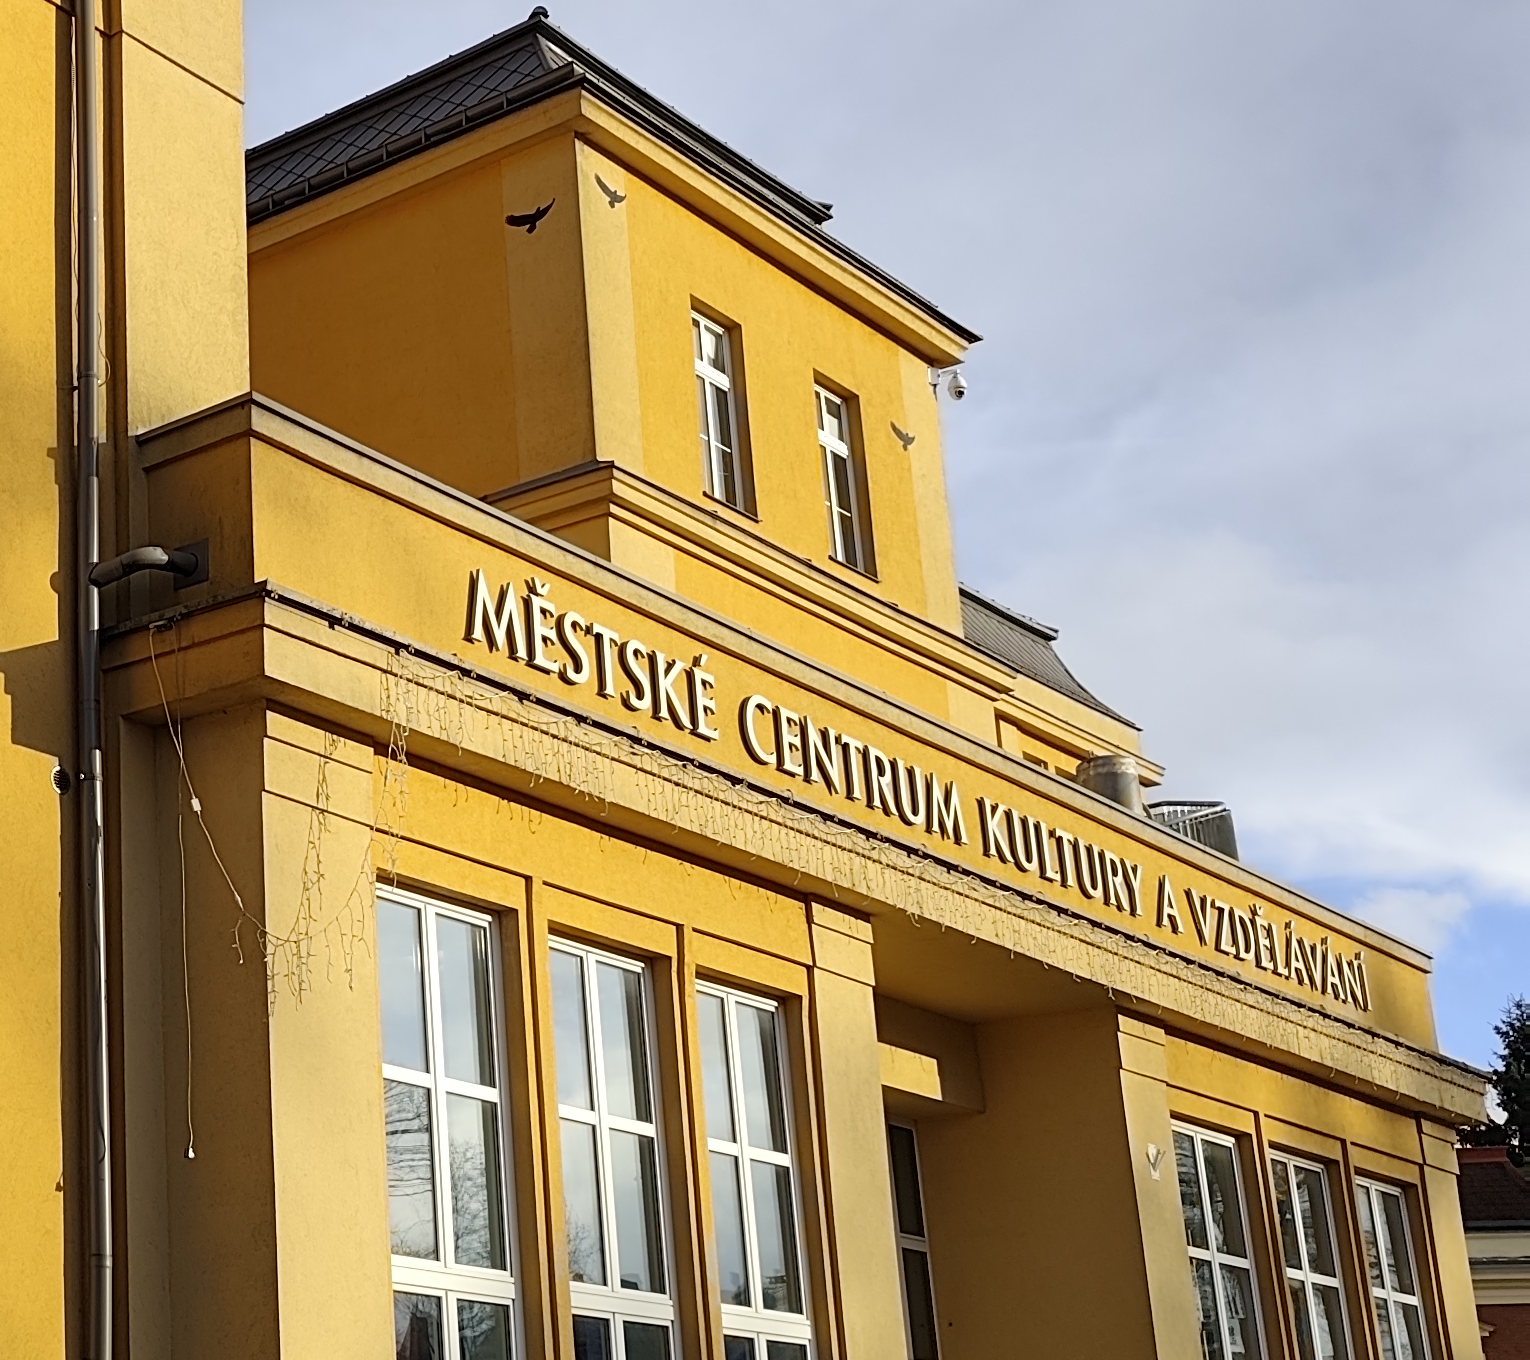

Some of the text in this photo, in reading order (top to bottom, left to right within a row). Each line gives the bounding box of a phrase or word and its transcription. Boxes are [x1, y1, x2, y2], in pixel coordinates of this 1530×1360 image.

[465, 568, 1373, 1012] MĚSTSKÉ CENTRUM KULTURY A VZDĚLÁVÁNÍ
